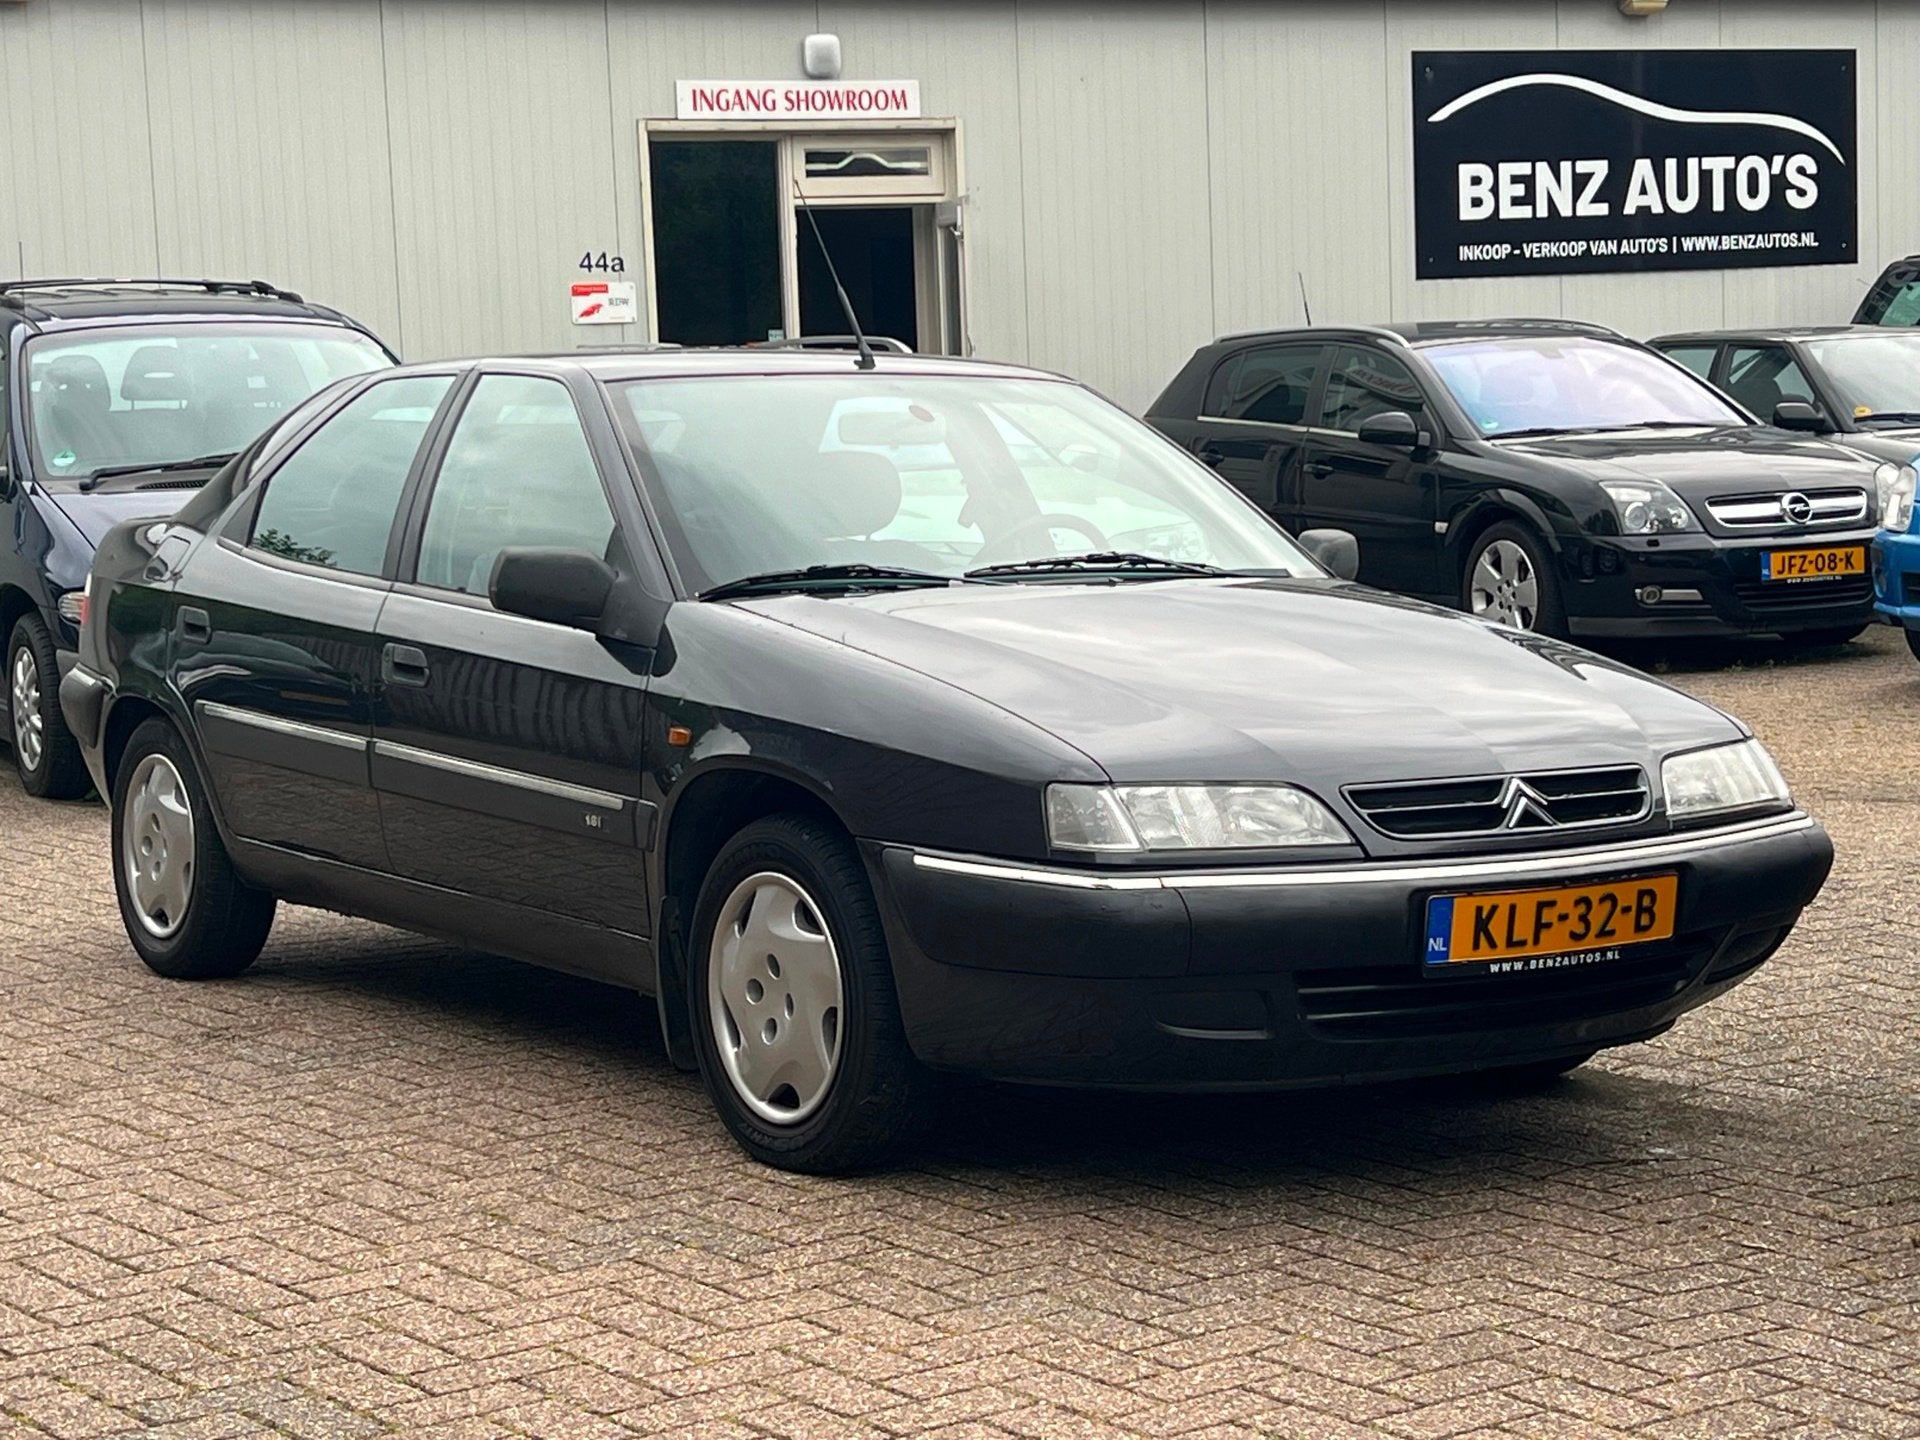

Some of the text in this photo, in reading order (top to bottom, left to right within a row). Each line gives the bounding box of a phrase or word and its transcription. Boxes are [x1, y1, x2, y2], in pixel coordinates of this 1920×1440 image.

[692, 88, 908, 112] INGANG SHOWROOM
[1457, 154, 1819, 221] BENZ AUTO'S
[1459, 243, 1511, 261] INKOOP
[1523, 241, 1587, 258] VERKOOP
[1589, 240, 1618, 256] VAN
[1620, 238, 1668, 255] AUTO'S
[1681, 232, 1819, 253] WWW.BENZAUTOS.NL
[579, 251, 625, 273] 44a
[1777, 551, 1855, 575] JFZ-08-K
[1472, 888, 1658, 951] KLF-32-B
[1428, 937, 1448, 952] NL
[1489, 950, 1621, 973] WWW.BENZAUTOS.NL
